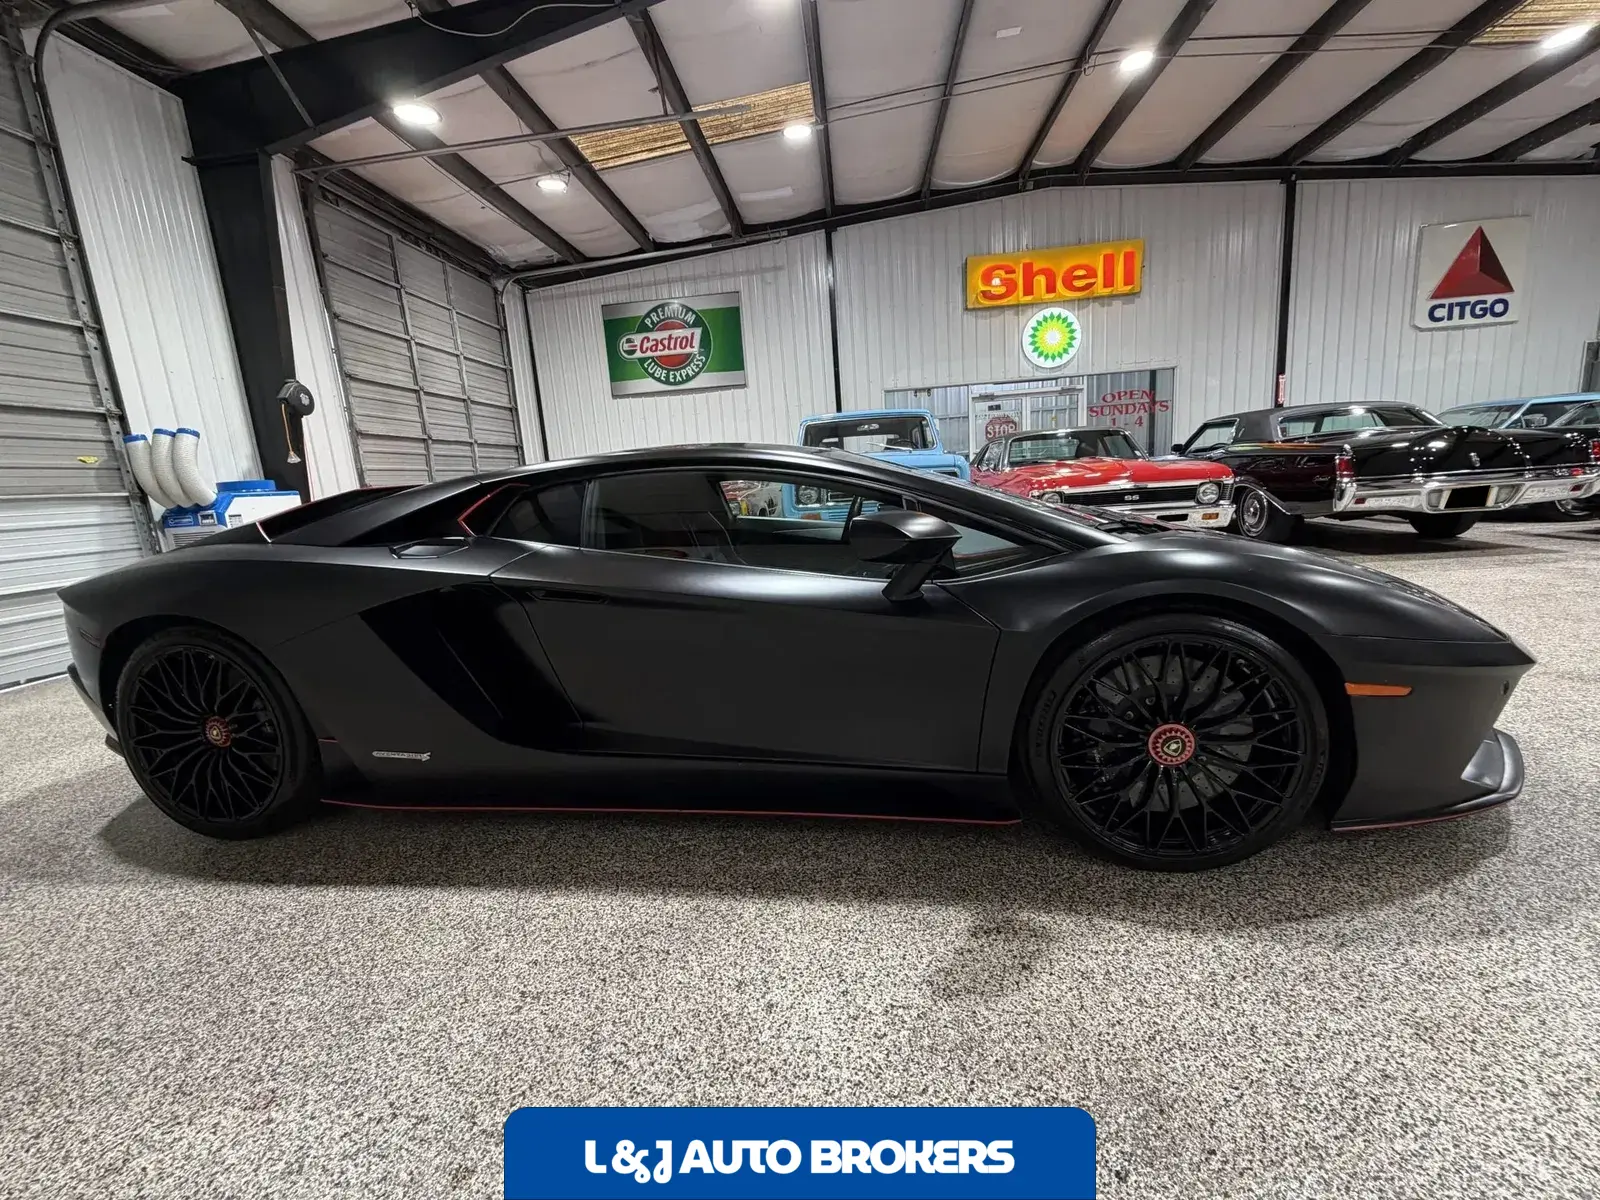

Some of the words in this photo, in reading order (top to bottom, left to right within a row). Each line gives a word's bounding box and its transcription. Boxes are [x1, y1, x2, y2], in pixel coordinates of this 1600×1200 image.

[979, 250, 1136, 302] Shell
[645, 306, 696, 328] PREMIUM
[1427, 297, 1510, 323] CITGO
[639, 332, 695, 354] Castrol
[643, 357, 668, 381] LUBE
[669, 354, 706, 383] EXPRESS
[1101, 389, 1156, 404] OPEN
[1088, 400, 1170, 418] SUNDAYS
[986, 423, 1016, 438] STOP
